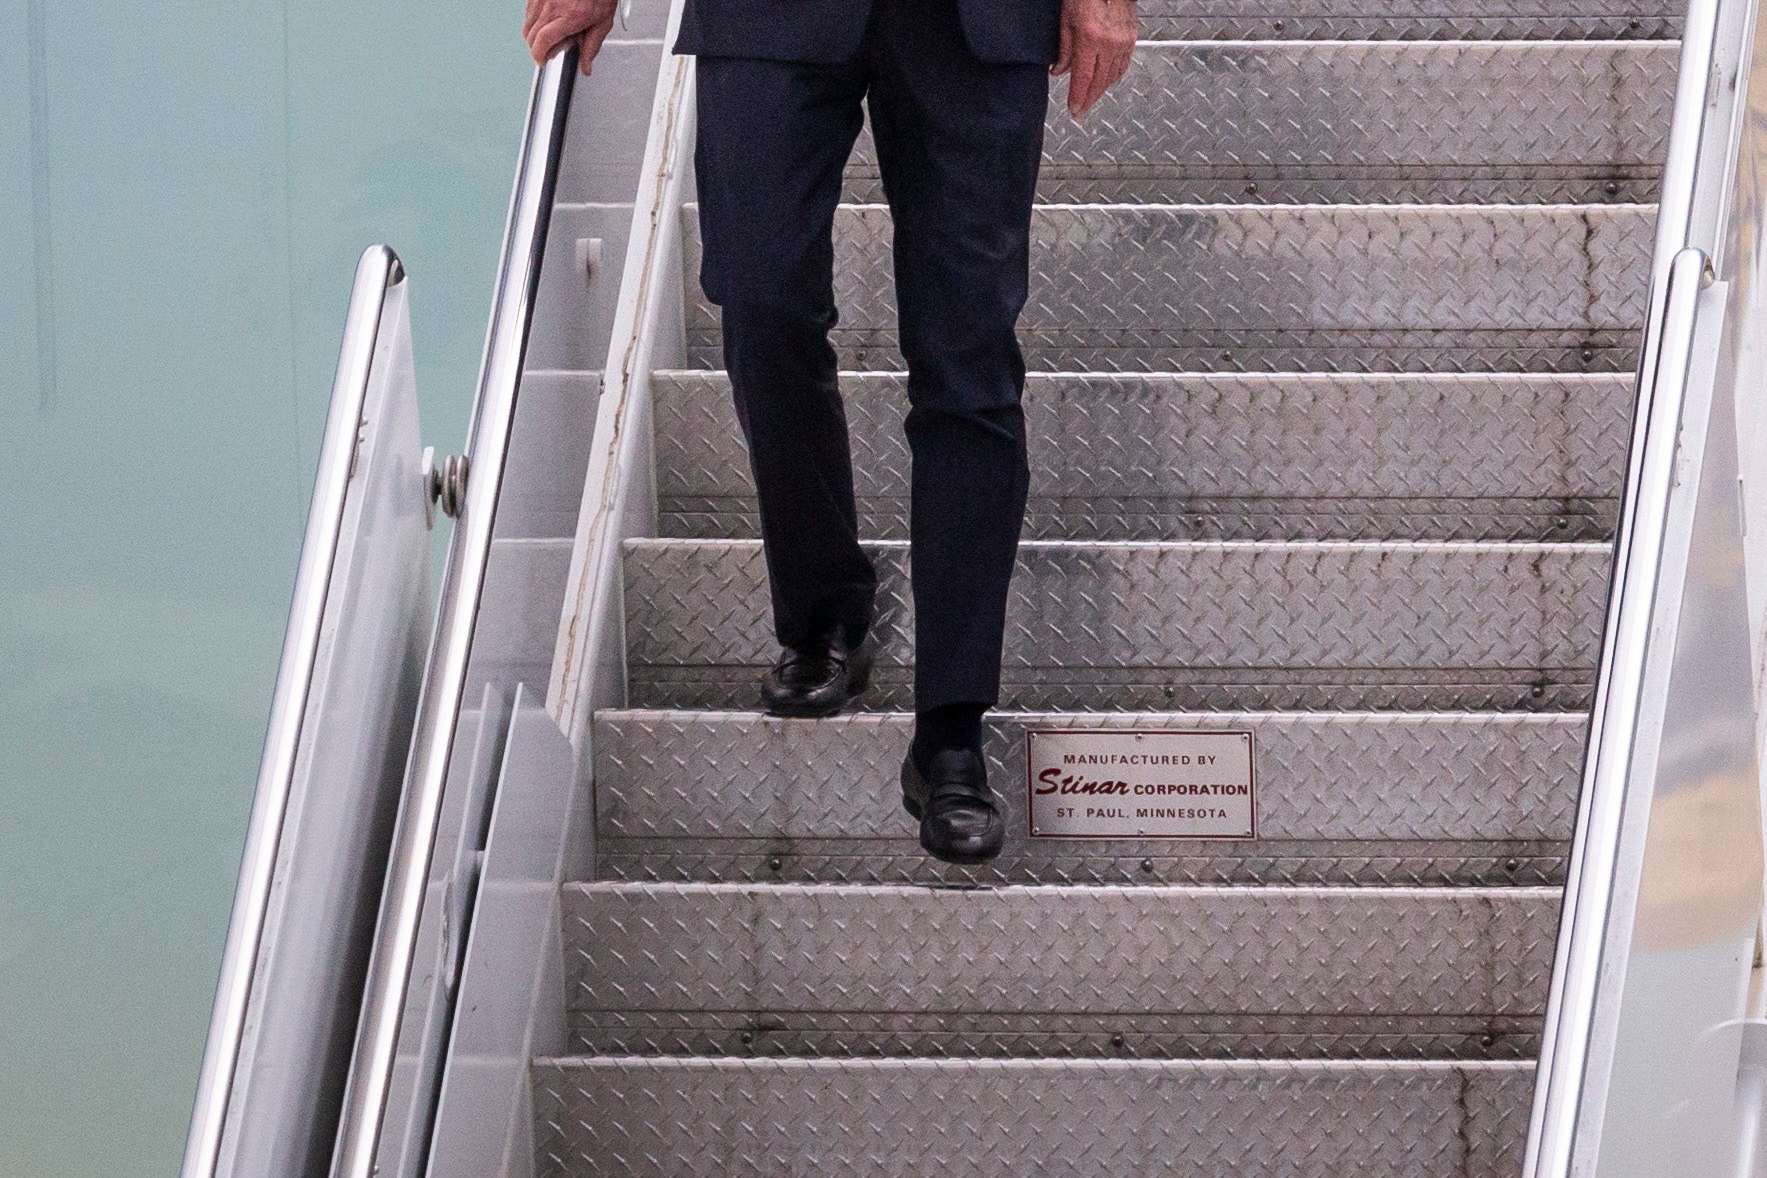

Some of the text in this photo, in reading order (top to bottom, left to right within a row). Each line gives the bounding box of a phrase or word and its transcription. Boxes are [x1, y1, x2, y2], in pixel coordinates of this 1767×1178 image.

[1063, 754, 1217, 765] MANUFACTURED BY
[1034, 768, 1248, 796] Stinar CORPORATION
[1056, 808, 1227, 819] ST. PAUL, MINNESOTA
